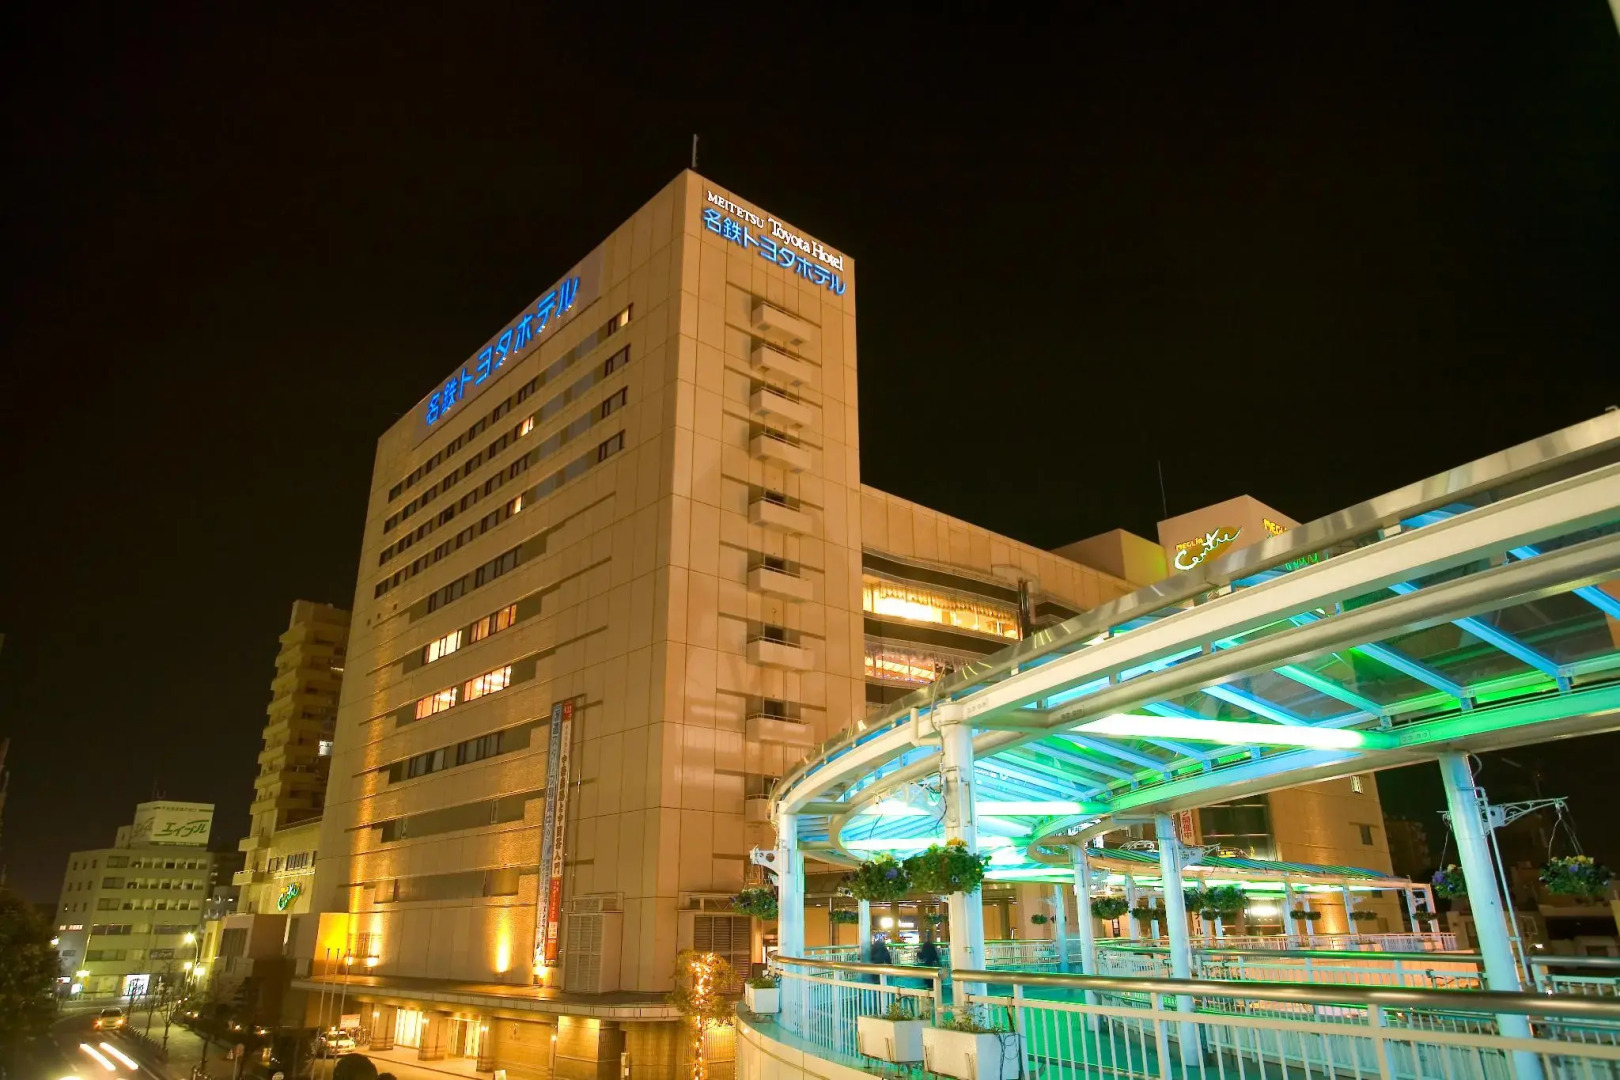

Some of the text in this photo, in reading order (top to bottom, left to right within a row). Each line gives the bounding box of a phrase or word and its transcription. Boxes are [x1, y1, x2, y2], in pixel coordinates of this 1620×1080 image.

[704, 208, 846, 295] 名鉄トヨタホテル
[707, 191, 843, 272] MEITETSU Toyota Hotel
[426, 277, 579, 426] 名鉄トヨタホテル
[154, 820, 210, 837] エイブル
